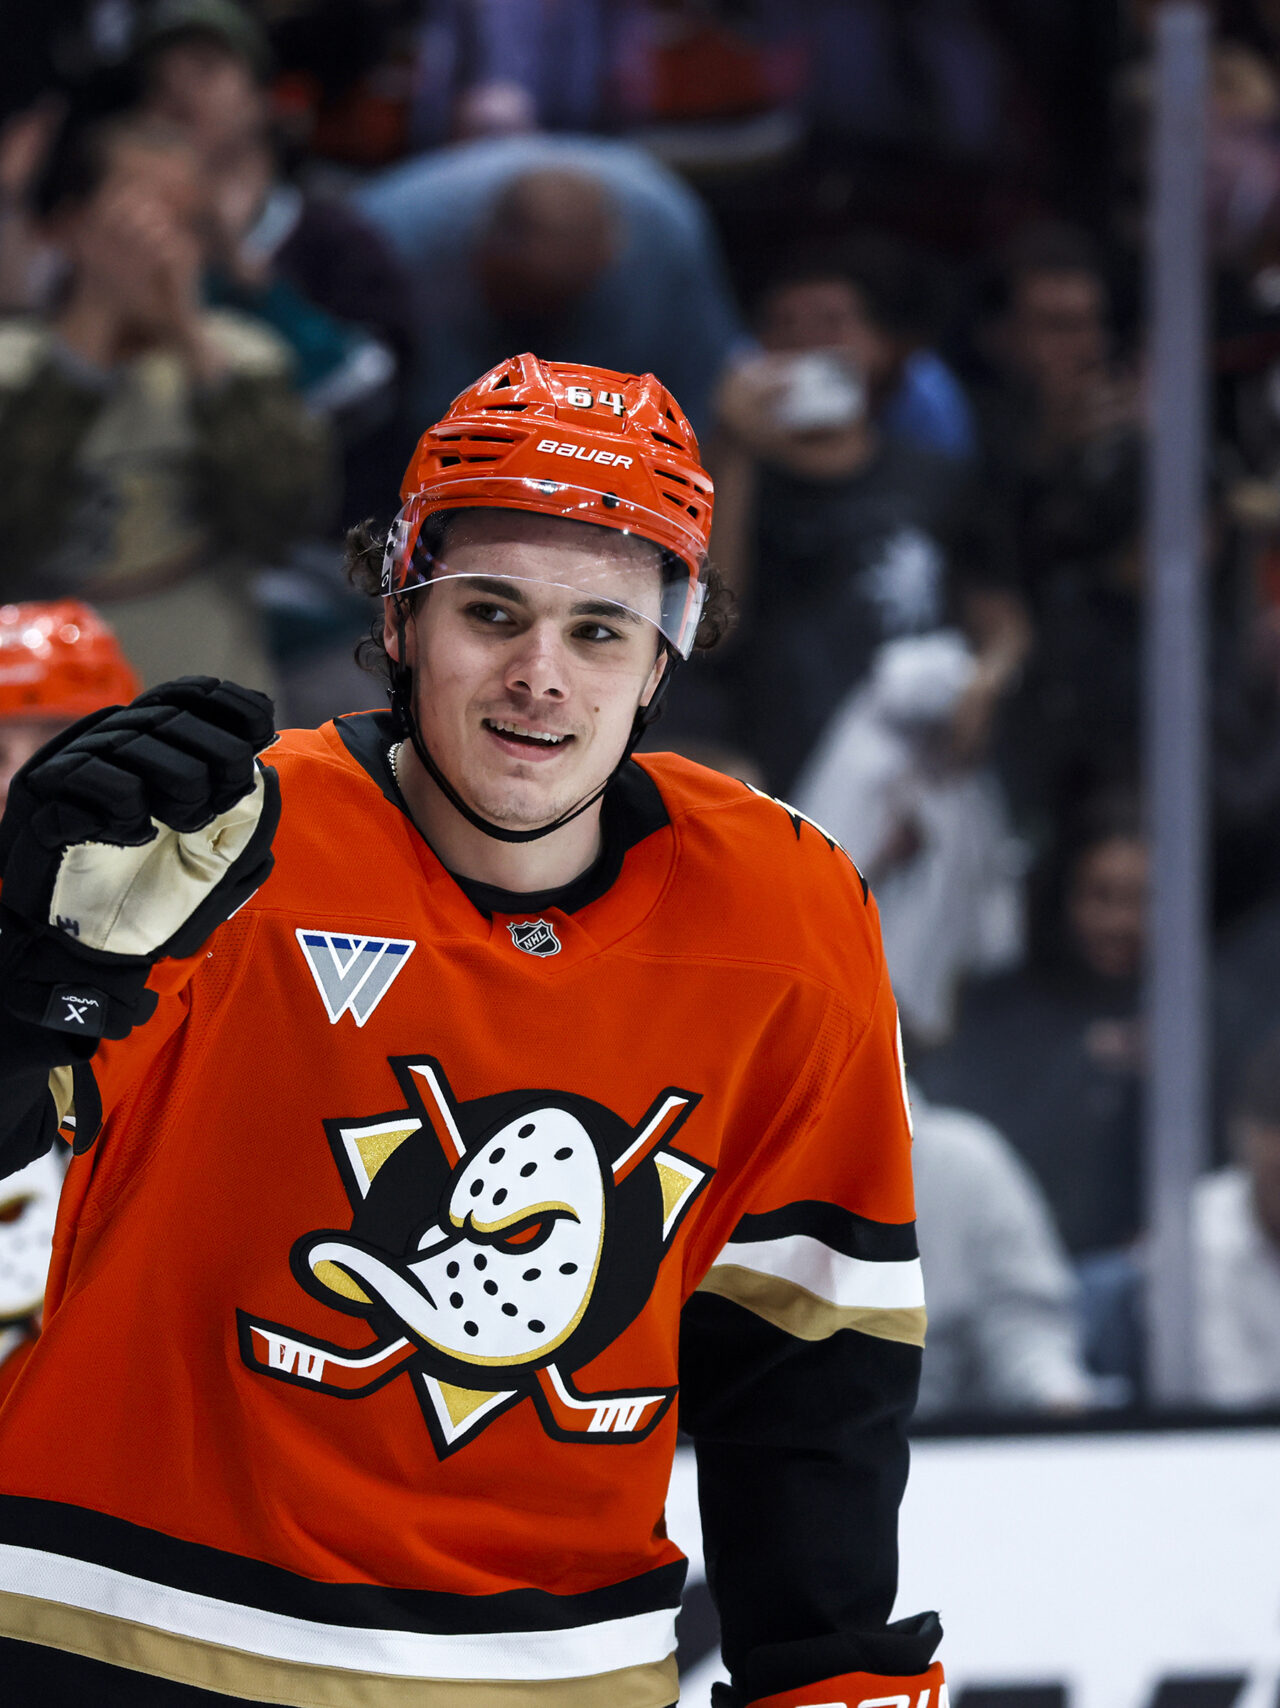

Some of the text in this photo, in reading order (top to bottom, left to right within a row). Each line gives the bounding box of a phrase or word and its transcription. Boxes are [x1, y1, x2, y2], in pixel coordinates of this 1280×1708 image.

[565, 386, 626, 417] 64
[536, 439, 634, 470] BAUER
[523, 930, 546, 950] NHL
